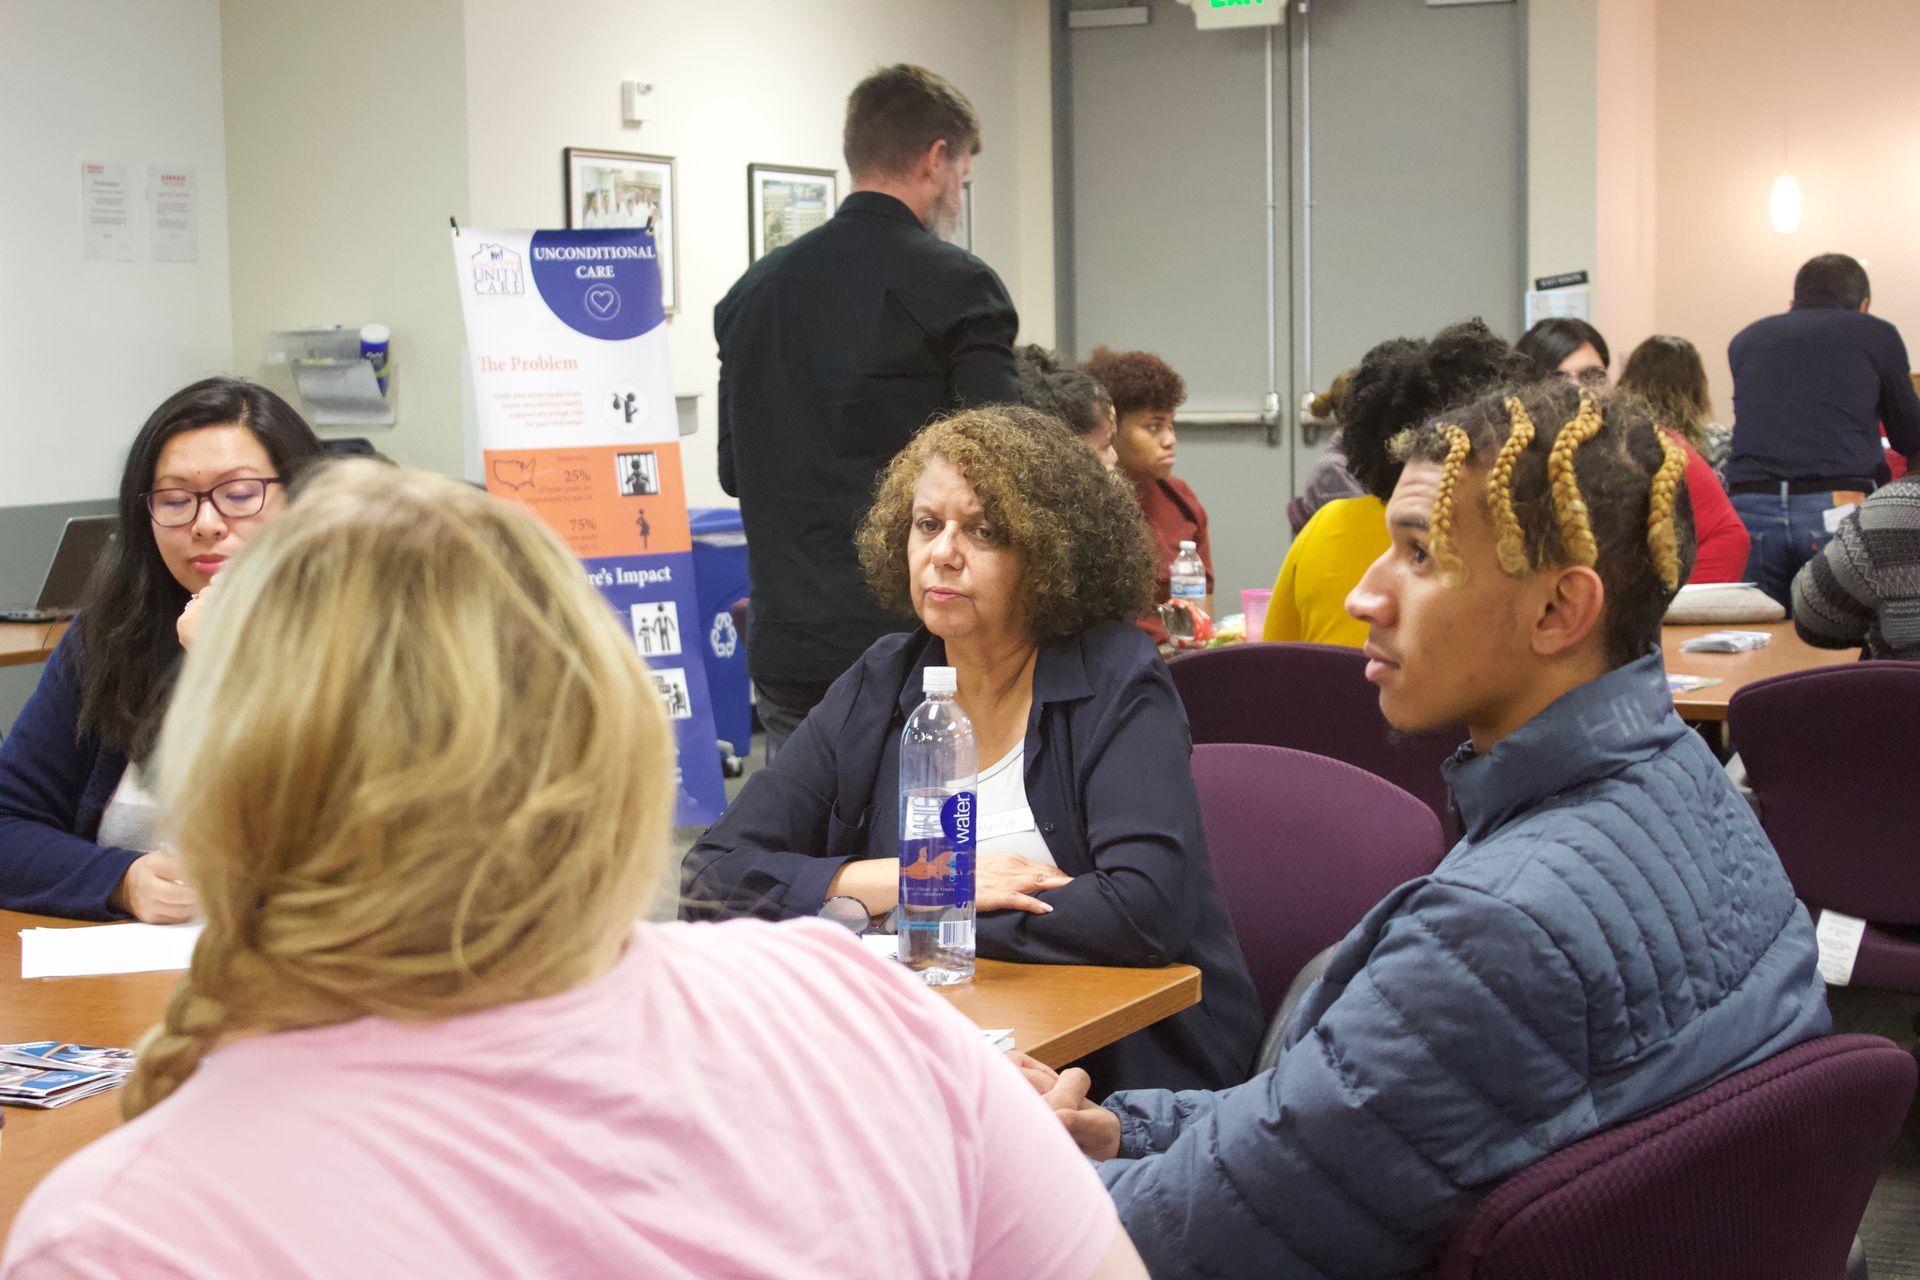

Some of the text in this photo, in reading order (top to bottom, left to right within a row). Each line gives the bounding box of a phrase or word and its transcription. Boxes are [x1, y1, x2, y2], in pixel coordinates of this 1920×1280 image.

[534, 245, 656, 260] UNCONDITIONAL
[473, 268, 520, 281] UNITY
[575, 265, 615, 279] CARE
[473, 281, 521, 294] CARE
[479, 354, 578, 372] The Problem
[565, 470, 592, 482] 25%
[570, 518, 597, 531] 75%
[585, 566, 672, 588] re's Impact
[953, 794, 971, 844] water
